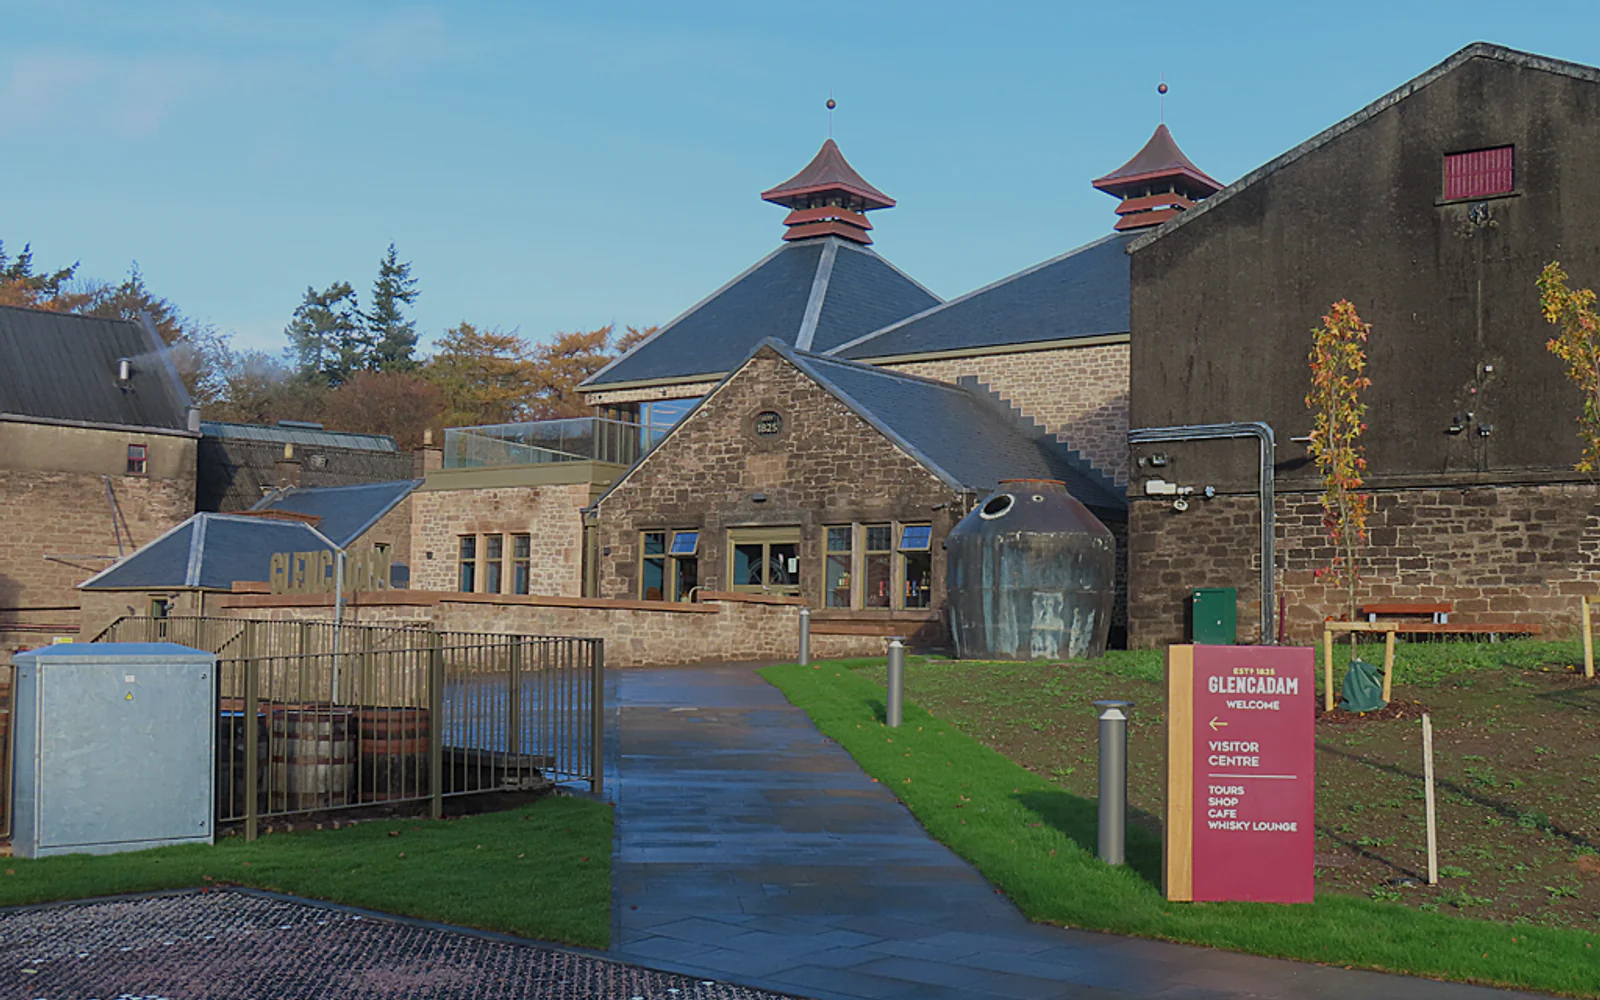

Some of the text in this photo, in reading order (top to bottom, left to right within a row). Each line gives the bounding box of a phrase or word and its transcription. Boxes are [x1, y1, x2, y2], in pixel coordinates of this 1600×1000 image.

[1208, 676, 1298, 695] GLENCADAM
[1226, 700, 1280, 710] WELCOME
[1208, 741, 1259, 752] VISITOR
[1208, 755, 1260, 767] CENTRE
[1208, 785, 1245, 795] TOURS
[1208, 797, 1239, 806] SHOP
[1208, 809, 1237, 818] CAFE
[1208, 821, 1298, 832] WHISKY LOUNGE
